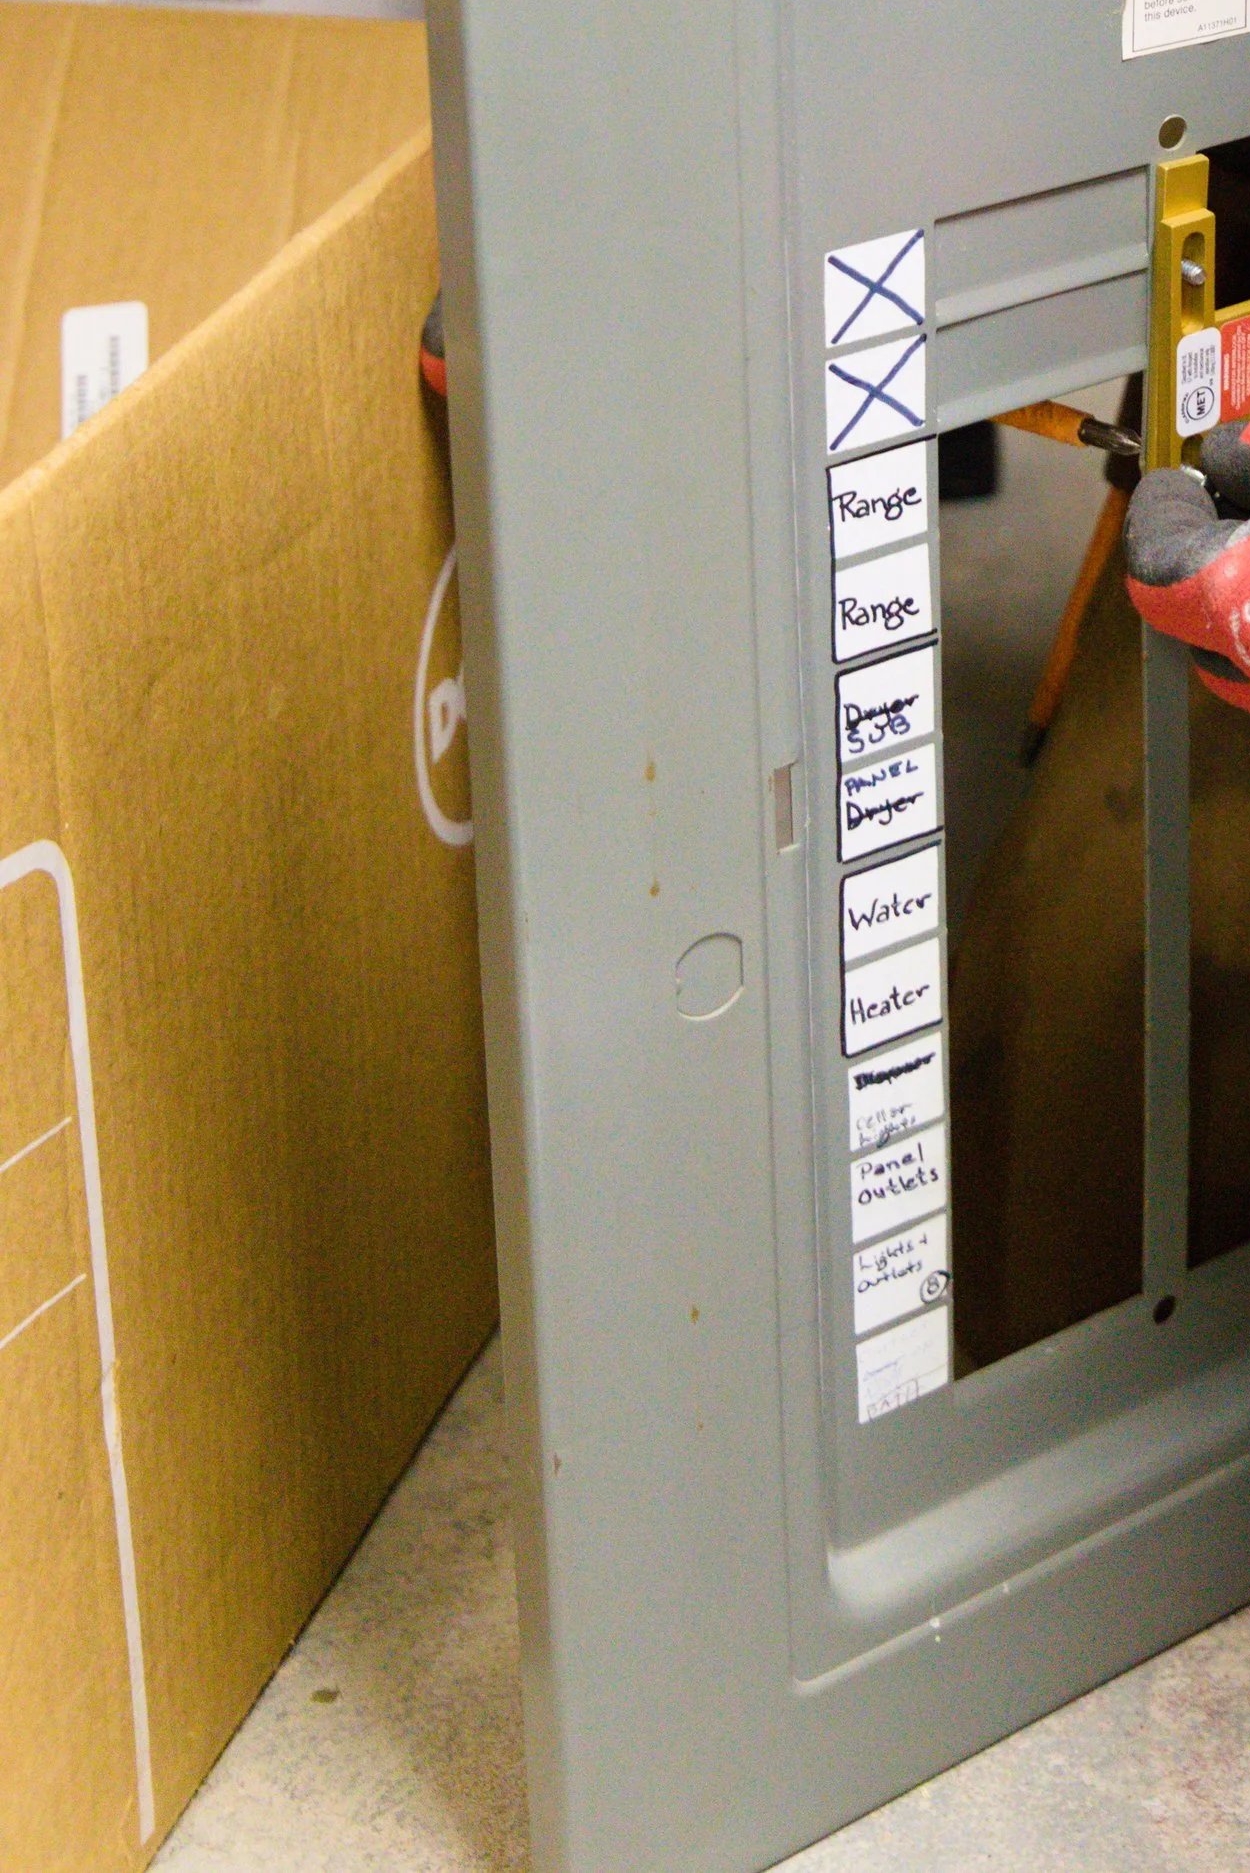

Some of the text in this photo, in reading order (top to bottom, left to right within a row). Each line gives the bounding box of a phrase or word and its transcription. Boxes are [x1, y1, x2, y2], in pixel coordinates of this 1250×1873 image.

[1144, 3, 1197, 23] this device.
[1196, 391, 1206, 416] MET
[834, 487, 922, 520] Range
[839, 595, 919, 629] Range
[845, 758, 919, 797] PANEL
[848, 892, 932, 931] Water
[851, 984, 931, 1025] Heater
[858, 1142, 924, 1181] Panel
